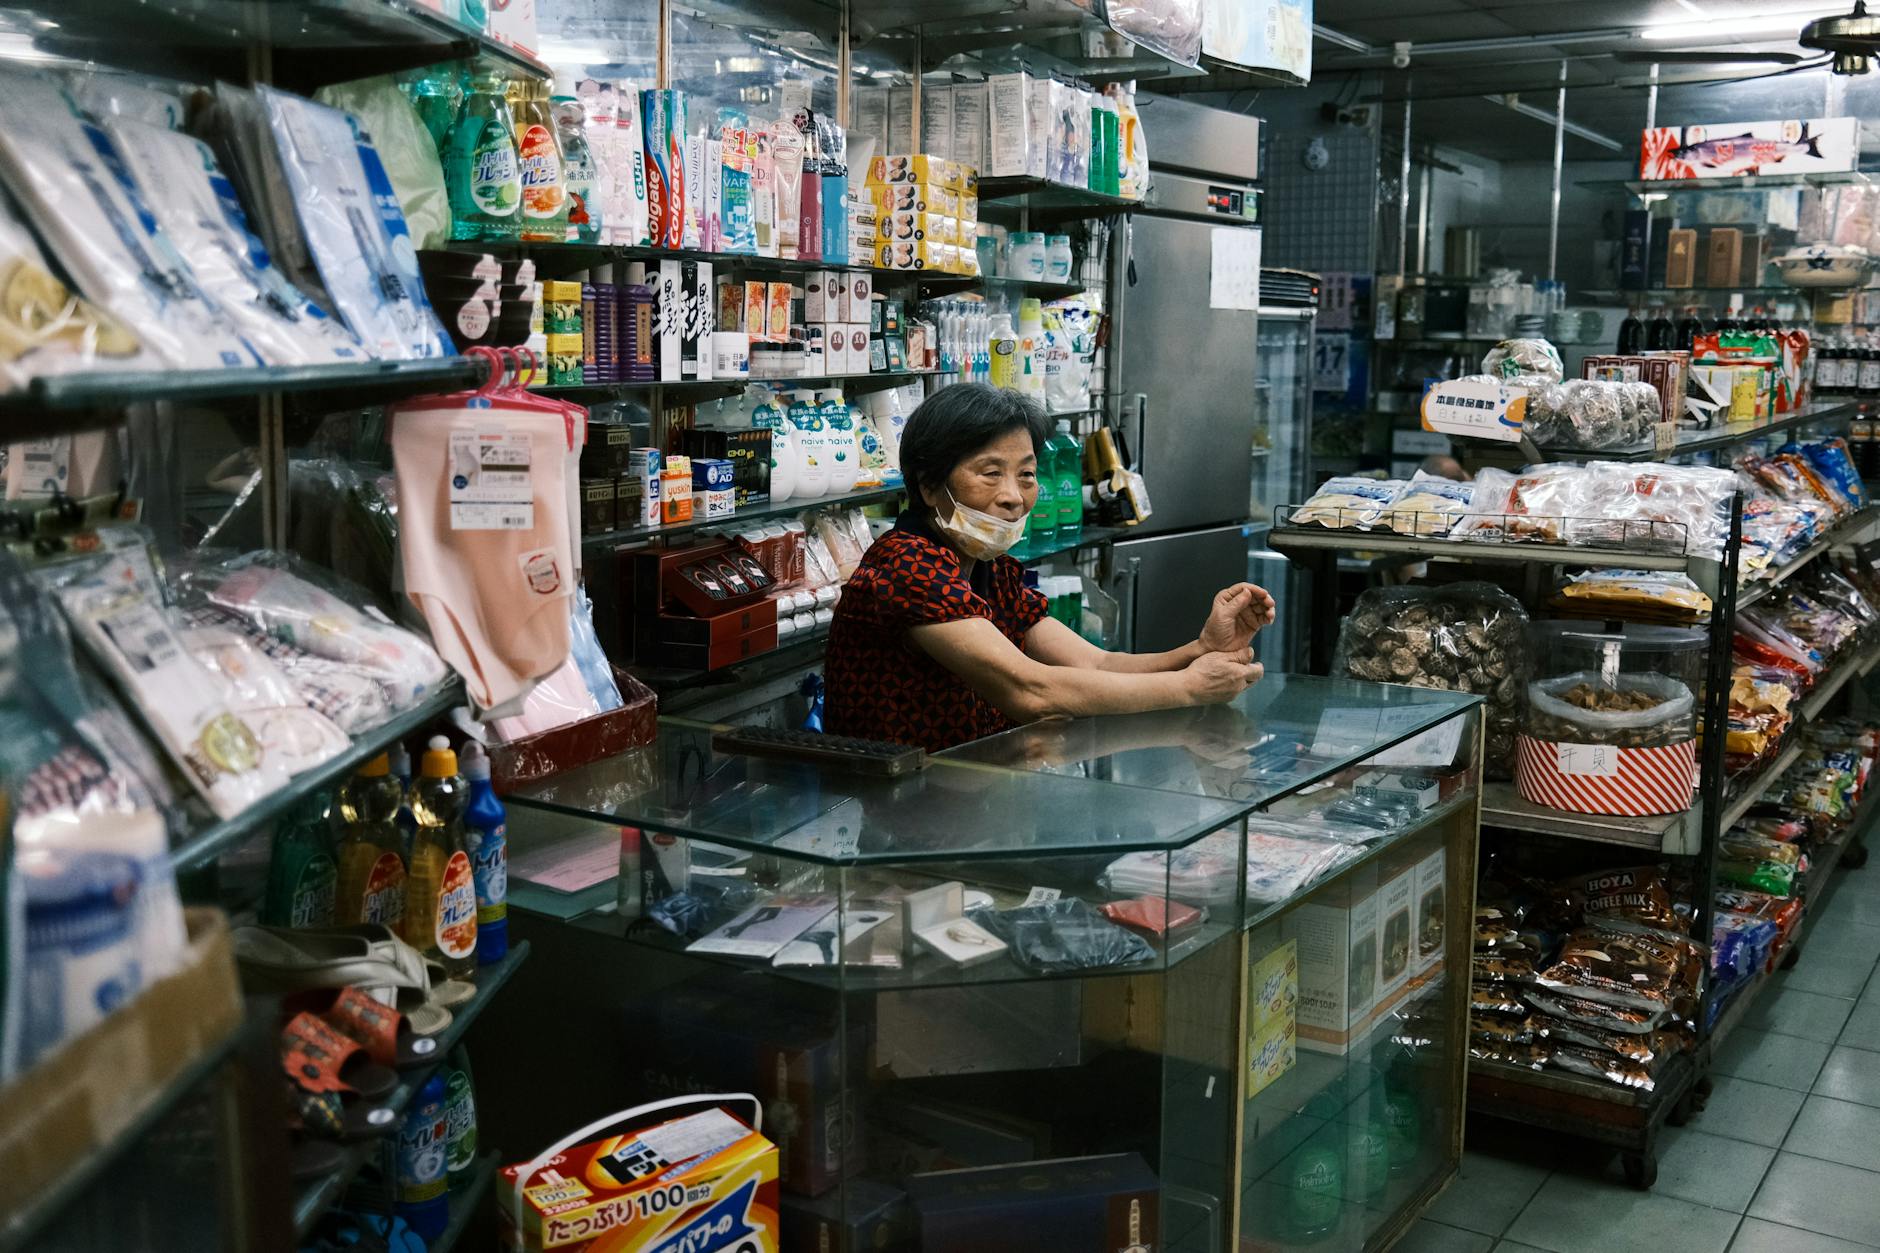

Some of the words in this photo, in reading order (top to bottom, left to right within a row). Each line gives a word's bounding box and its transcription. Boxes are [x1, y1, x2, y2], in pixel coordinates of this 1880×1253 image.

[669, 151, 682, 245] Colgate
[649, 169, 663, 245] Colgate
[801, 438, 824, 446] naive
[827, 437, 853, 445] naive
[719, 474, 733, 483] AD
[667, 484, 690, 498] yuskin
[1588, 874, 1633, 891] HOYA
[1584, 894, 1621, 913] COFFEE
[1623, 892, 1647, 906] MIX
